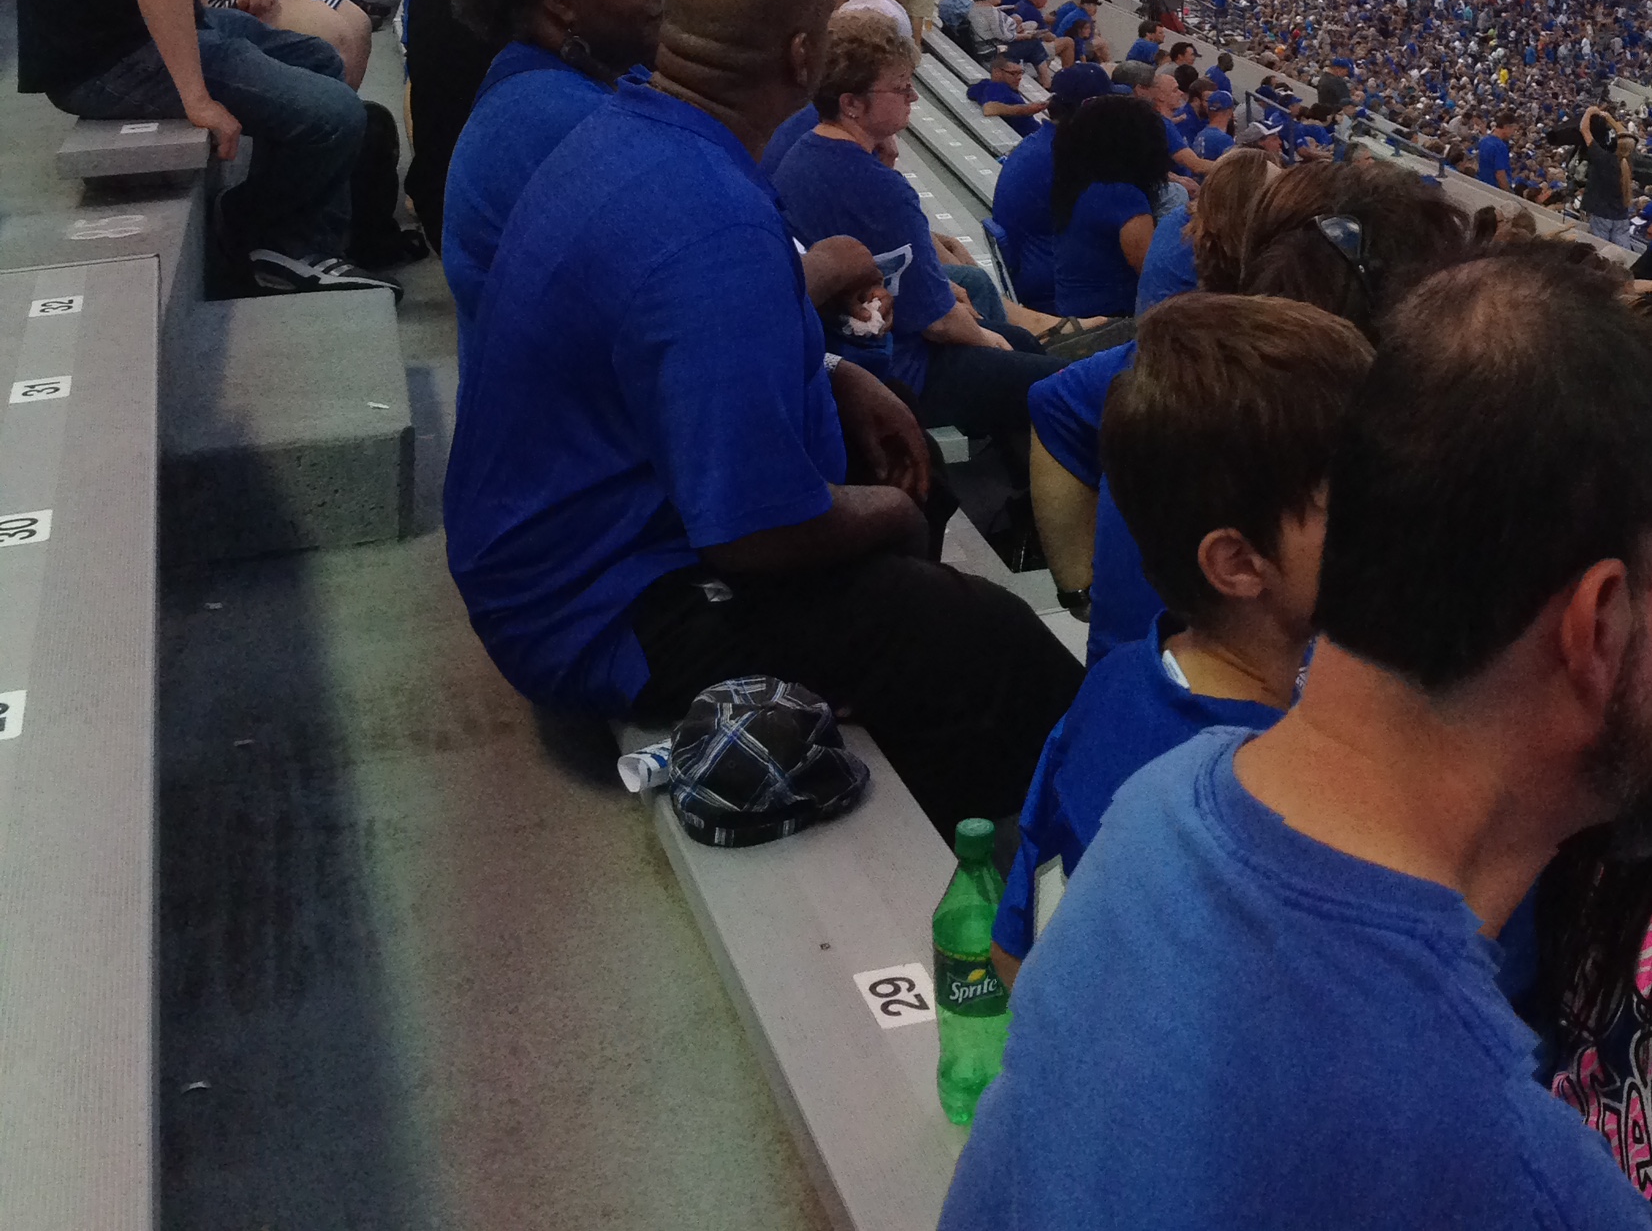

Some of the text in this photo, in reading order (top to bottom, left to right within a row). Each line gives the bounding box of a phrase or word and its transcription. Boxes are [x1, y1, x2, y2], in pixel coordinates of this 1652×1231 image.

[40, 300, 73, 313] 32
[22, 382, 60, 396] 31
[0, 517, 38, 542] 30
[869, 977, 930, 1016] 29
[949, 976, 998, 1004] Sprite
